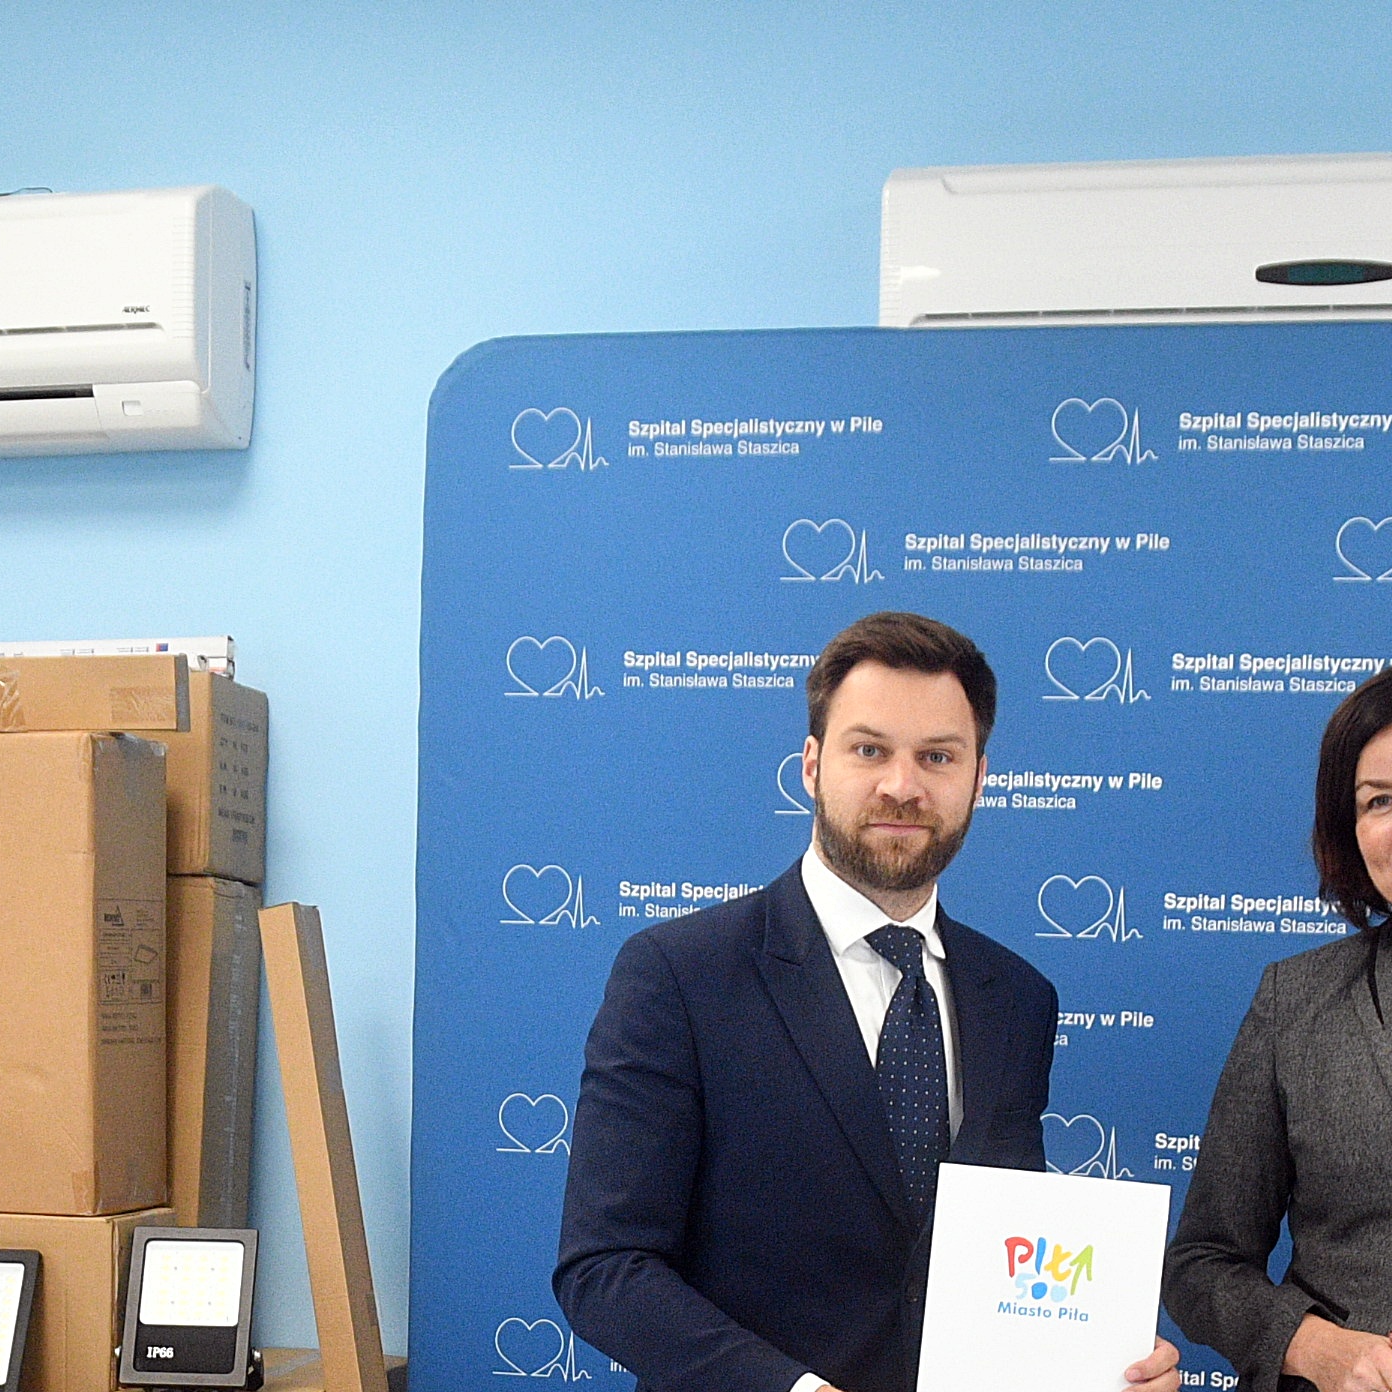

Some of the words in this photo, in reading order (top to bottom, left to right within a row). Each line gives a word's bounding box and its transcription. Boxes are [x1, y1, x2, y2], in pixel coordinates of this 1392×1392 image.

[628, 419, 687, 441] Szpital
[690, 418, 826, 439] Specjalistyczny
[850, 416, 883, 433] Pile
[1179, 412, 1242, 433] Szpital
[1246, 411, 1392, 433] Specjalistyczny
[654, 441, 733, 457] Stanisława
[737, 439, 800, 456] Staszica
[1207, 435, 1293, 451] Stanisława
[1297, 434, 1365, 450] Staszica
[905, 533, 965, 554] Szpital
[969, 533, 1111, 554] Specjalistyczny
[1115, 537, 1131, 550] w
[1135, 533, 1170, 550] Pile
[931, 555, 1014, 571] Stanisława
[1018, 555, 1083, 571] Staszica
[623, 650, 681, 671] Szpital
[685, 650, 820, 672] Specjalistyczny
[1172, 652, 1234, 674] Szpital
[1239, 653, 1385, 676] Specjalistyczny
[649, 672, 728, 688] Stanisława
[732, 673, 794, 688] Staszica
[1199, 675, 1285, 692] Stanisława
[1289, 676, 1357, 693] Staszica
[1128, 772, 1163, 790] Pile
[1011, 792, 1077, 810] Staszica
[619, 880, 677, 901] Szpital
[1163, 892, 1226, 915] Szpital
[1191, 916, 1276, 933] Stanisława
[1280, 917, 1347, 935] Staszica
[1120, 1010, 1155, 1028] Pile
[997, 1301, 1052, 1319] Miasto
[1058, 1307, 1090, 1323] Piła
[146, 1345, 175, 1359] IP66
